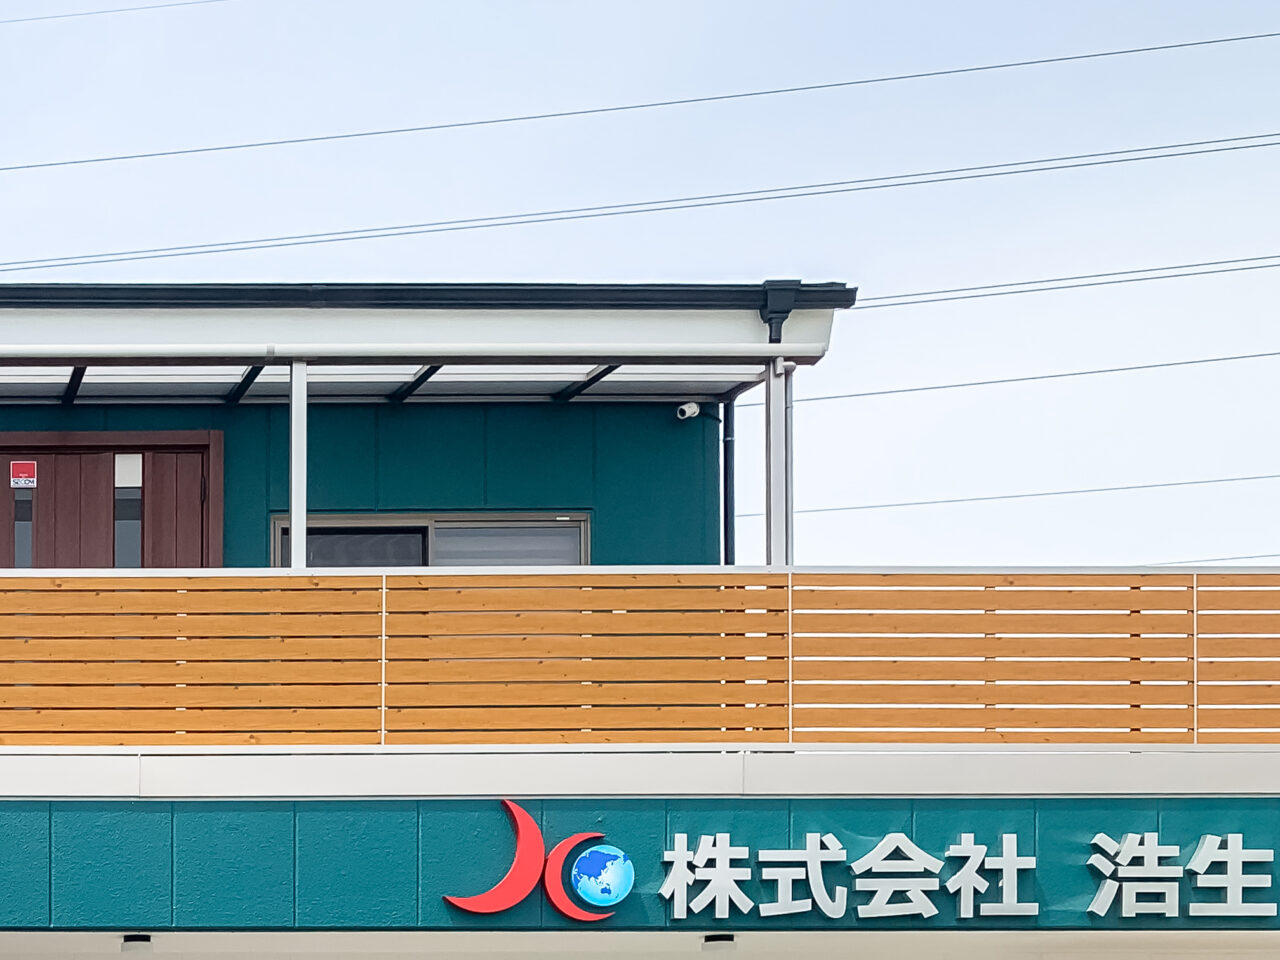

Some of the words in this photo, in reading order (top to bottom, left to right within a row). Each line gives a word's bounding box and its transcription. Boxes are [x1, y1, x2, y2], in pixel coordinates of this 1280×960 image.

[658, 832, 1040, 919] 株式会社
[1086, 832, 1278, 918] 浩生
